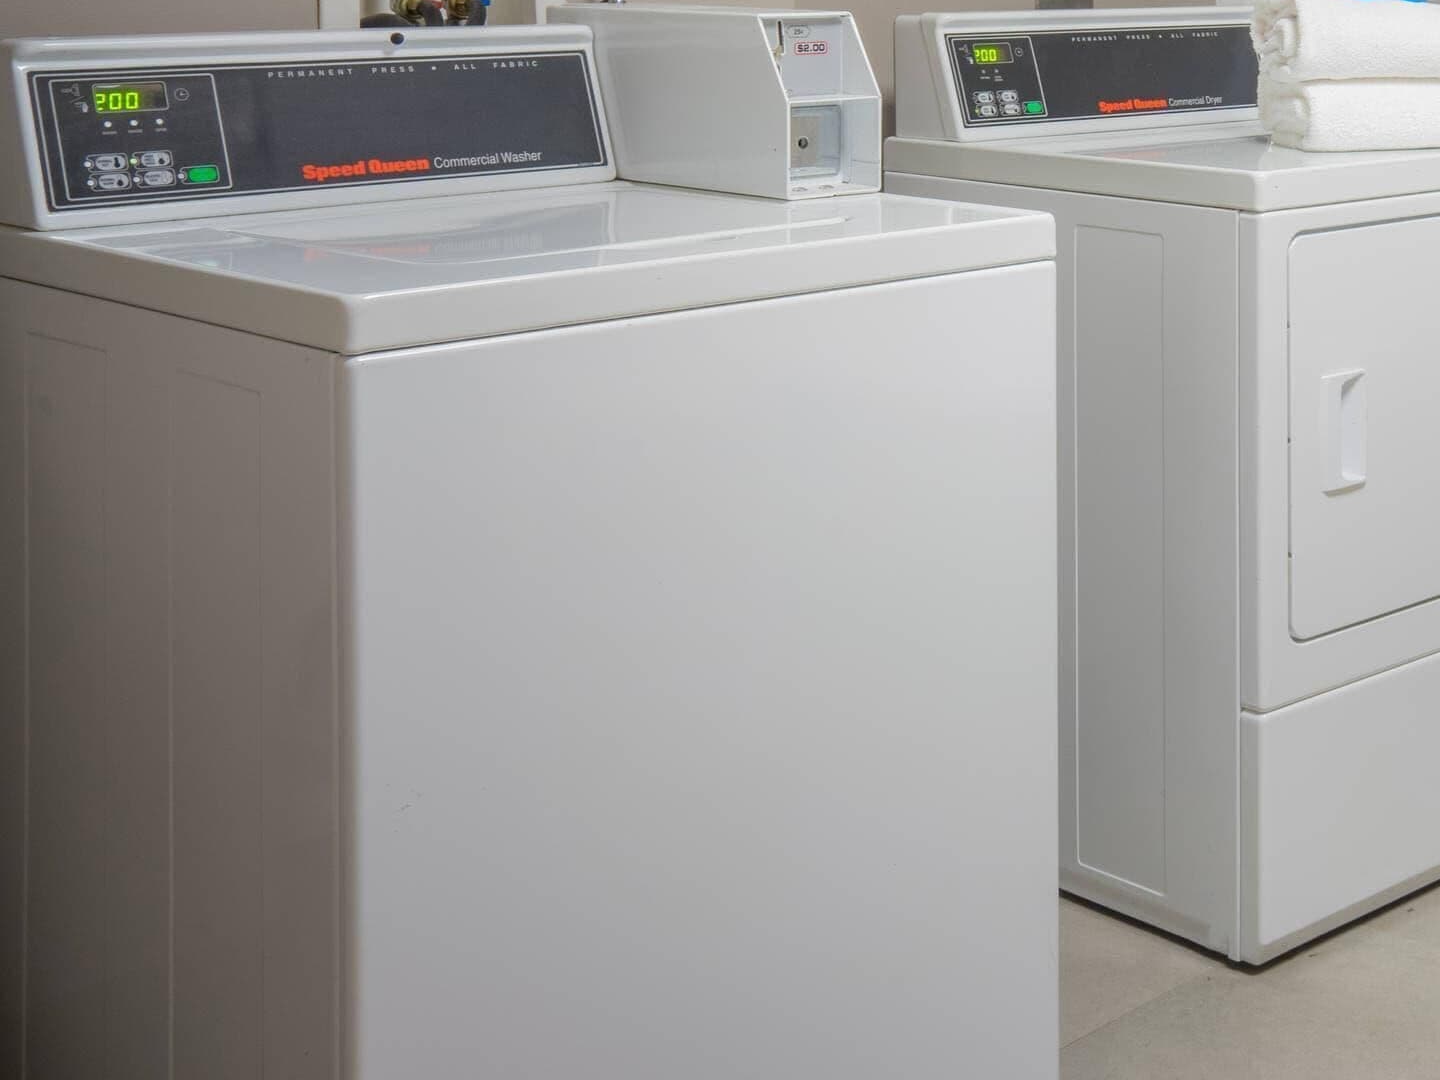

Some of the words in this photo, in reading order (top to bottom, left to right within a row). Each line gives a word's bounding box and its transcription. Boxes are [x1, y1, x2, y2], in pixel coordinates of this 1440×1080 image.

[797, 43, 825, 52] $2.00
[267, 68, 353, 78] PERMANENT
[371, 65, 415, 74] PRESS
[492, 59, 538, 69] FABRIC
[1098, 99, 1133, 113] Speed
[1134, 97, 1168, 110] Queen
[1168, 95, 1206, 106] Commercial
[1206, 94, 1223, 106] Dryer
[303, 160, 366, 181] Speed
[368, 157, 430, 175] Queen
[433, 153, 499, 169] Commercial
[500, 151, 542, 164] Washer
